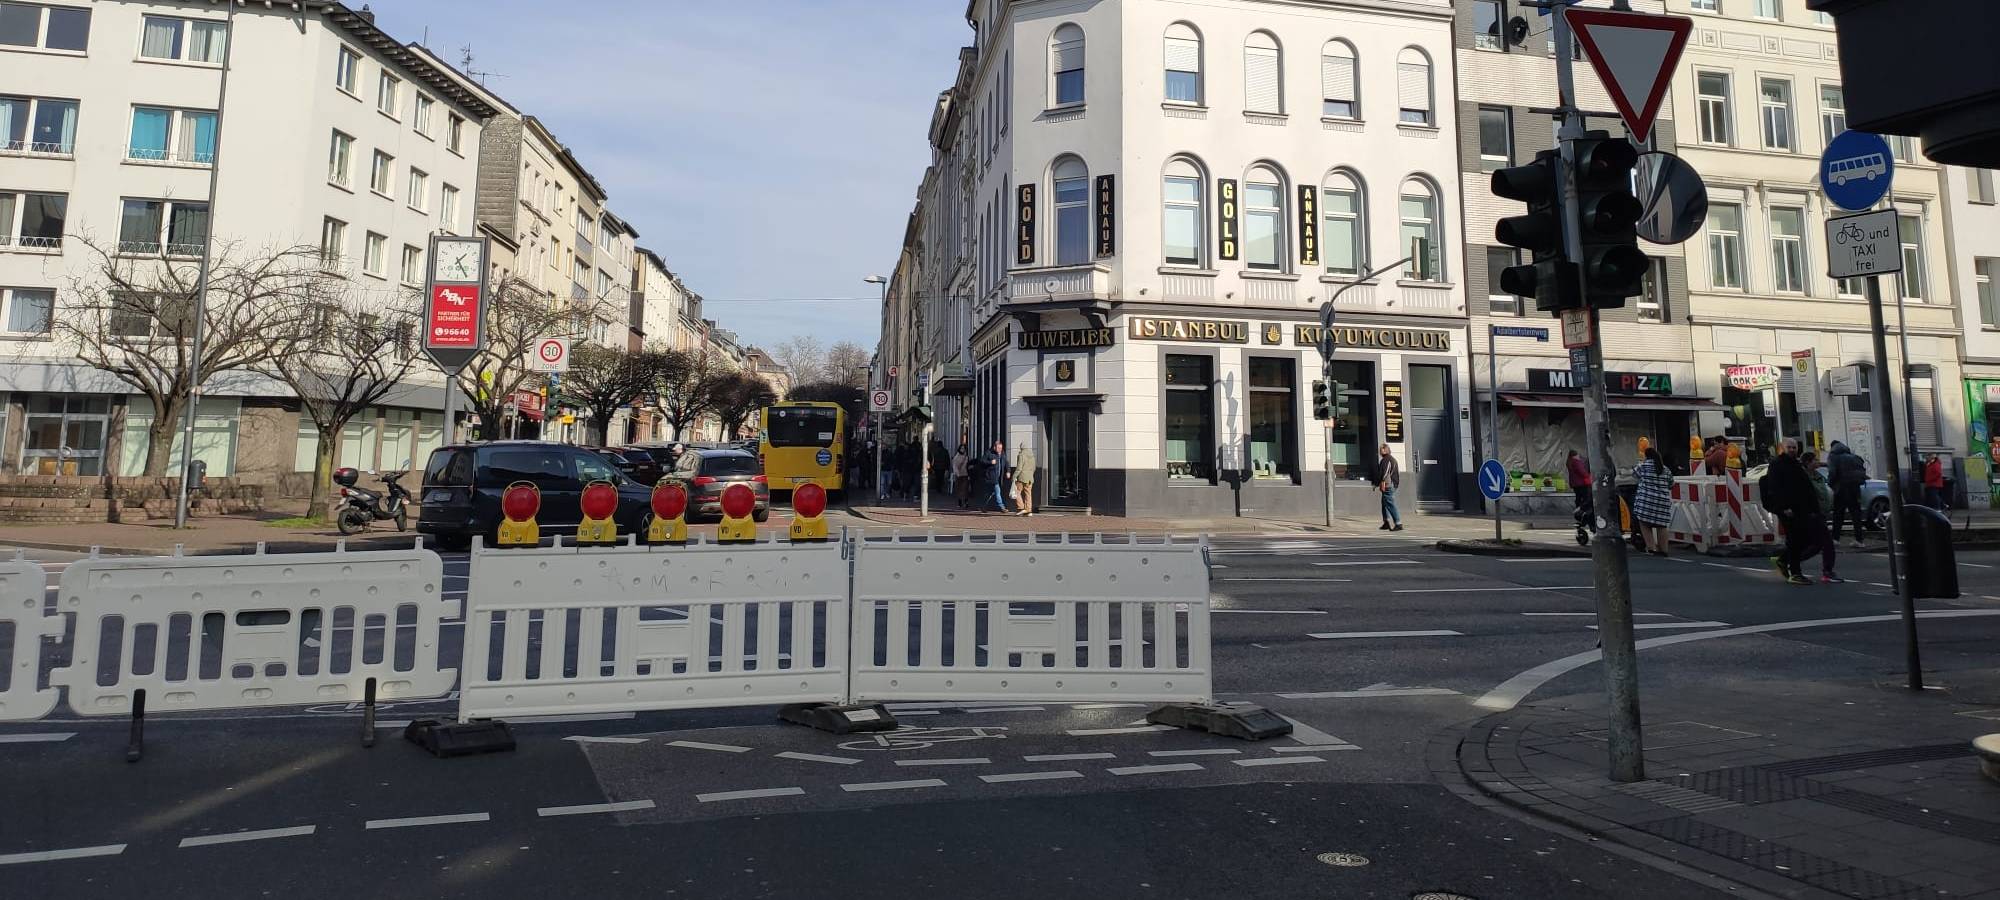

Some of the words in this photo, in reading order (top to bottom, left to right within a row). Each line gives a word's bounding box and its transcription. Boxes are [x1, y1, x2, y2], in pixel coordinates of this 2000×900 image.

[1022, 188, 1031, 260] GOLD
[1223, 183, 1234, 257] GOLD
[1305, 188, 1313, 261] ANKAUF
[1869, 226, 1889, 240] und
[1852, 243, 1876, 256] TAXI
[1856, 258, 1875, 270] frei
[439, 288, 466, 306] ABN
[1134, 318, 1247, 341] ISTANBUL
[1496, 326, 1548, 338] Adalbertsteinweg
[1019, 329, 1112, 349] JUWELIER
[544, 346, 559, 357] 30
[1727, 366, 1766, 377] CREATIVE
[1621, 375, 1672, 390] PIZZA
[876, 395, 886, 403] 30
[793, 525, 801, 533] VD
